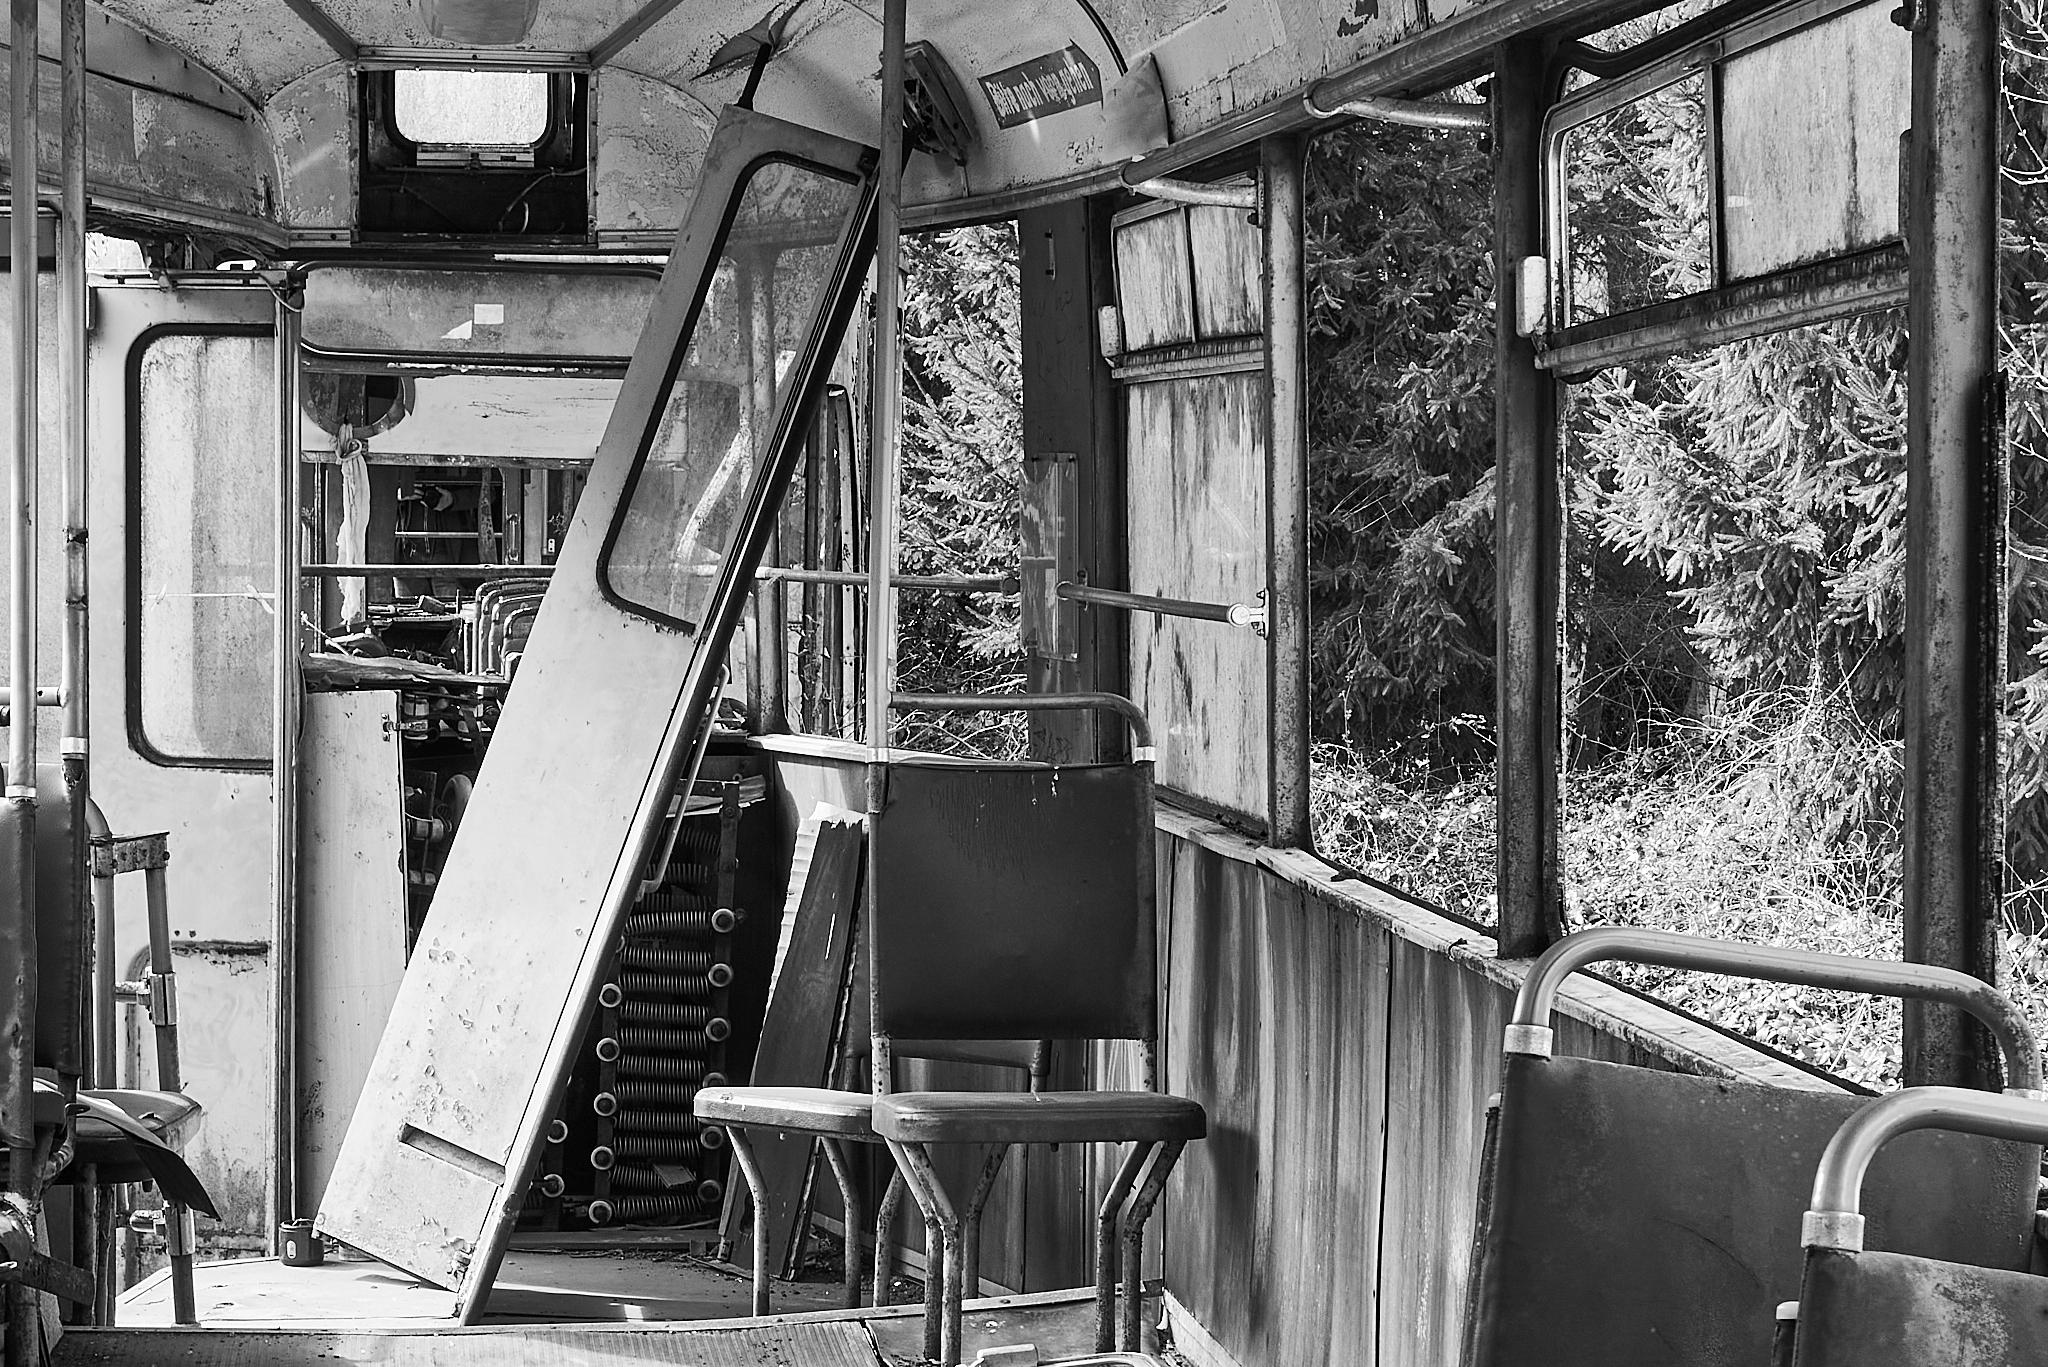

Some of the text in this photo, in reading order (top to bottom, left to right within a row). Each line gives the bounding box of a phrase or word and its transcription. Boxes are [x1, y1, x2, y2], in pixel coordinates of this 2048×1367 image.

[985, 81, 1020, 117] Bitte
[1013, 71, 1043, 110] nach
[1059, 57, 1093, 106] gehen
